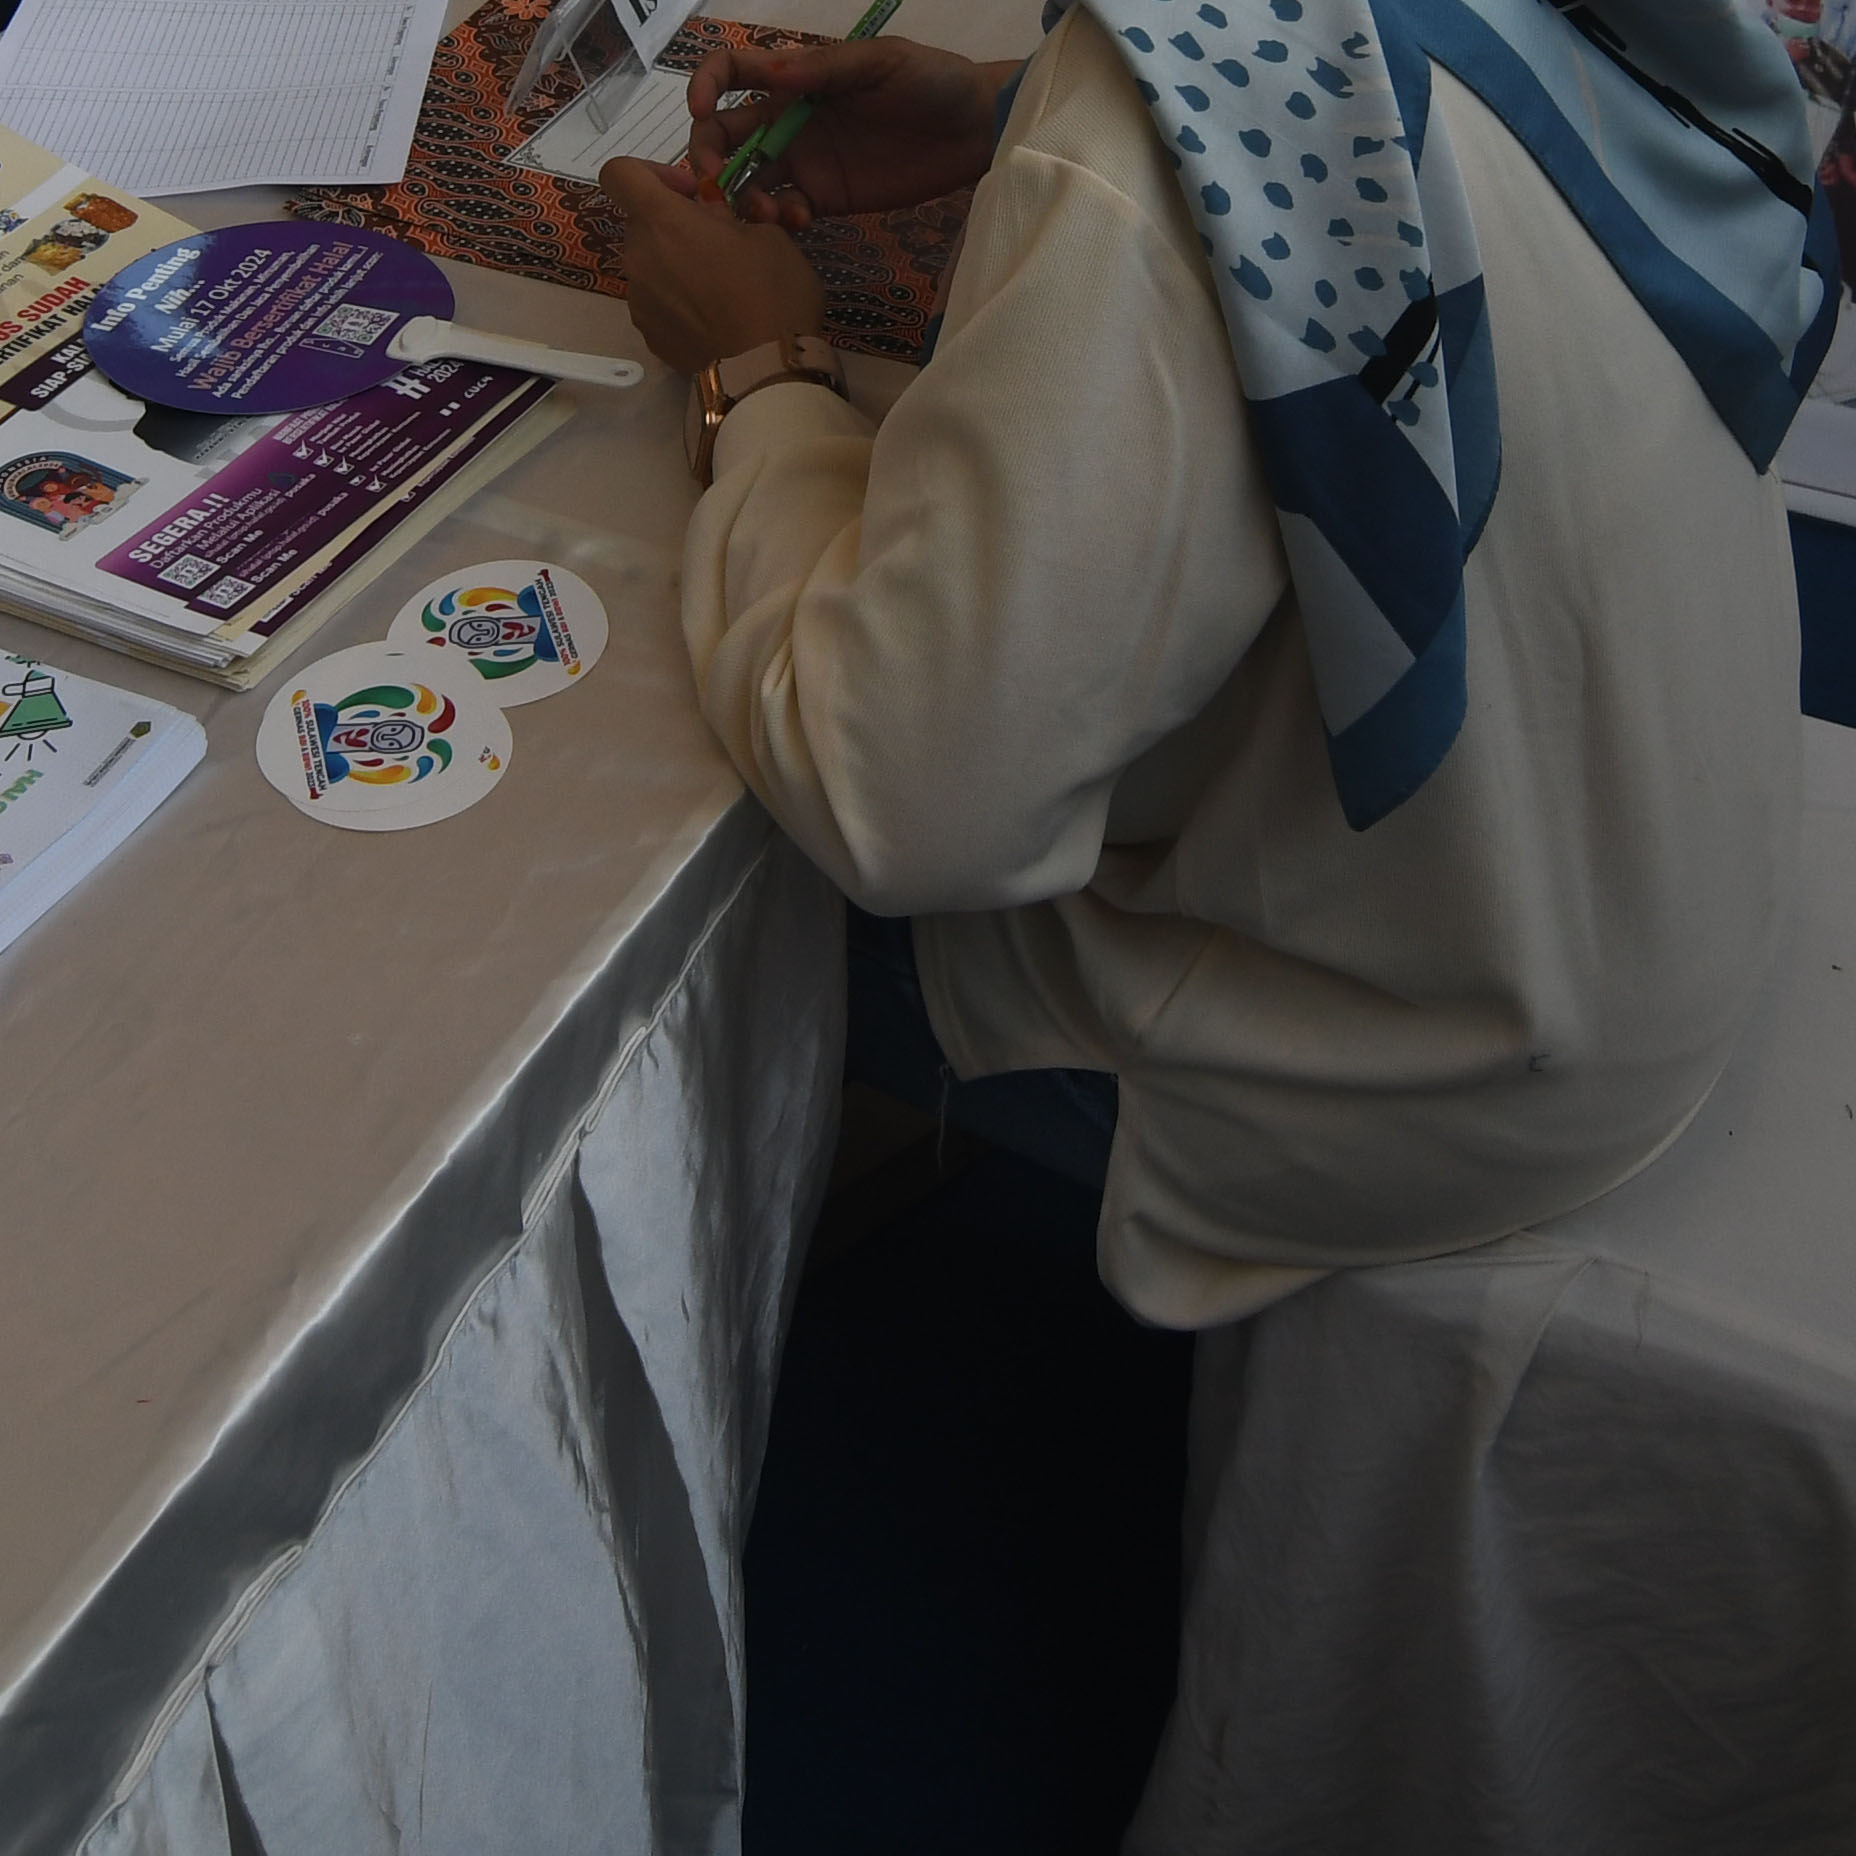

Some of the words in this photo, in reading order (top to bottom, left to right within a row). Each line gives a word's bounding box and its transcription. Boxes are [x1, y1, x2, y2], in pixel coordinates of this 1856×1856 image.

[18, 276, 90, 323] SUDAH
[91, 301, 136, 333] Info
[132, 247, 201, 300] Penting
[151, 310, 199, 353] Mulai
[191, 299, 215, 317] 17
[209, 279, 242, 302] Okt
[233, 249, 272, 283] 2024
[153, 279, 205, 315] Nih...
[188, 343, 242, 391] Wajib
[237, 273, 321, 350] Bersertifikat
[308, 241, 354, 284] Halal
[150, 529, 203, 569] Daftarkan
[203, 487, 263, 537] Produkmu
[216, 546, 244, 565] Scan
[535, 578, 550, 610] TENGAH
[545, 610, 564, 647] SULAWESI
[305, 720, 320, 758] SULAWESI
[313, 758, 327, 791] TENGAH
[2, 769, 44, 801] HAI
